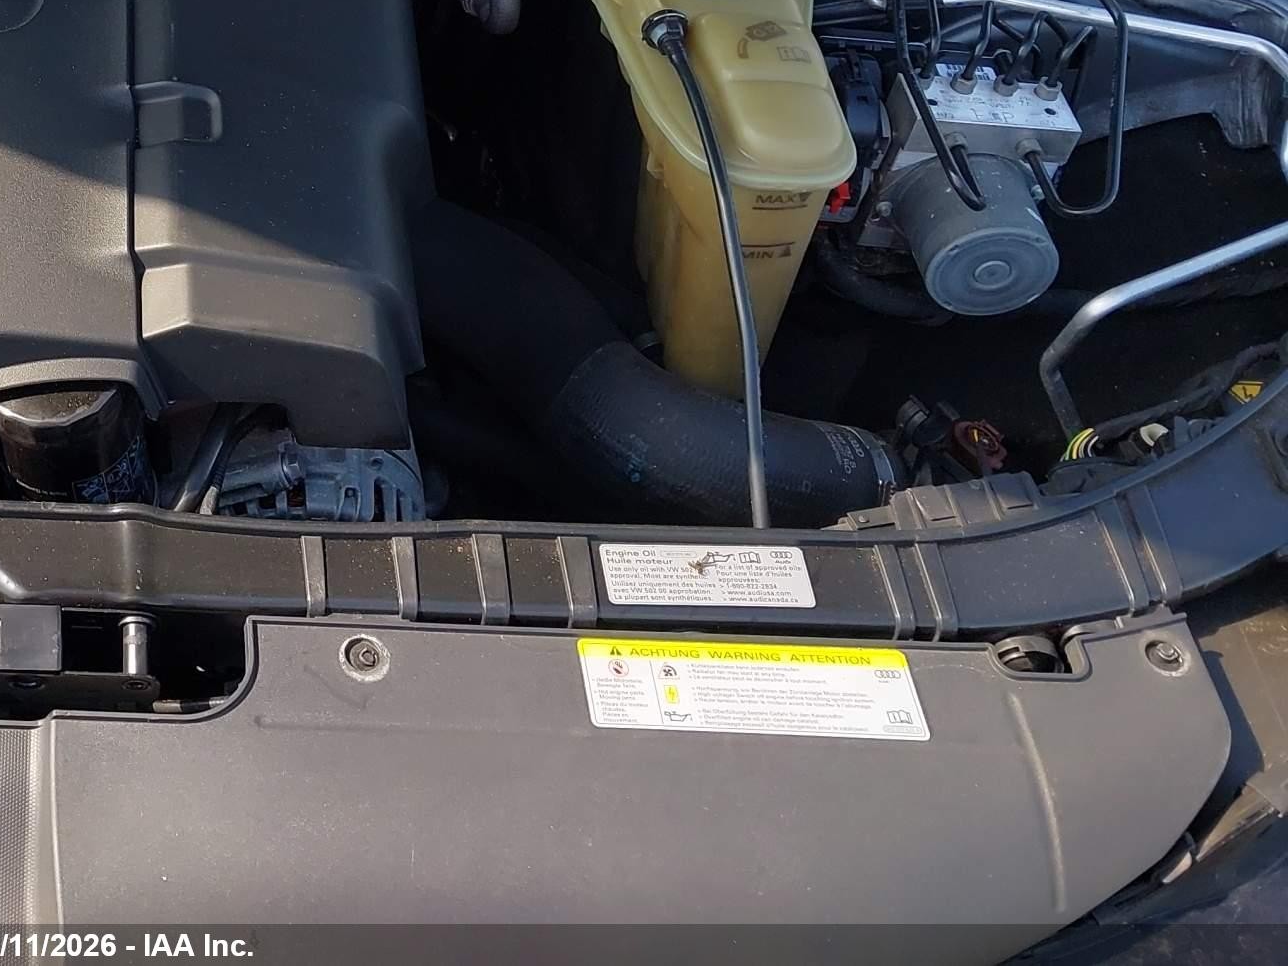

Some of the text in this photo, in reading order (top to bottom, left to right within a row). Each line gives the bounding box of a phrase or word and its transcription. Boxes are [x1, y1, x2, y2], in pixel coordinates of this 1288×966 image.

[756, 194, 796, 203] MAX
[630, 648, 871, 664] ACHTUNG WARNING ATTENTION
